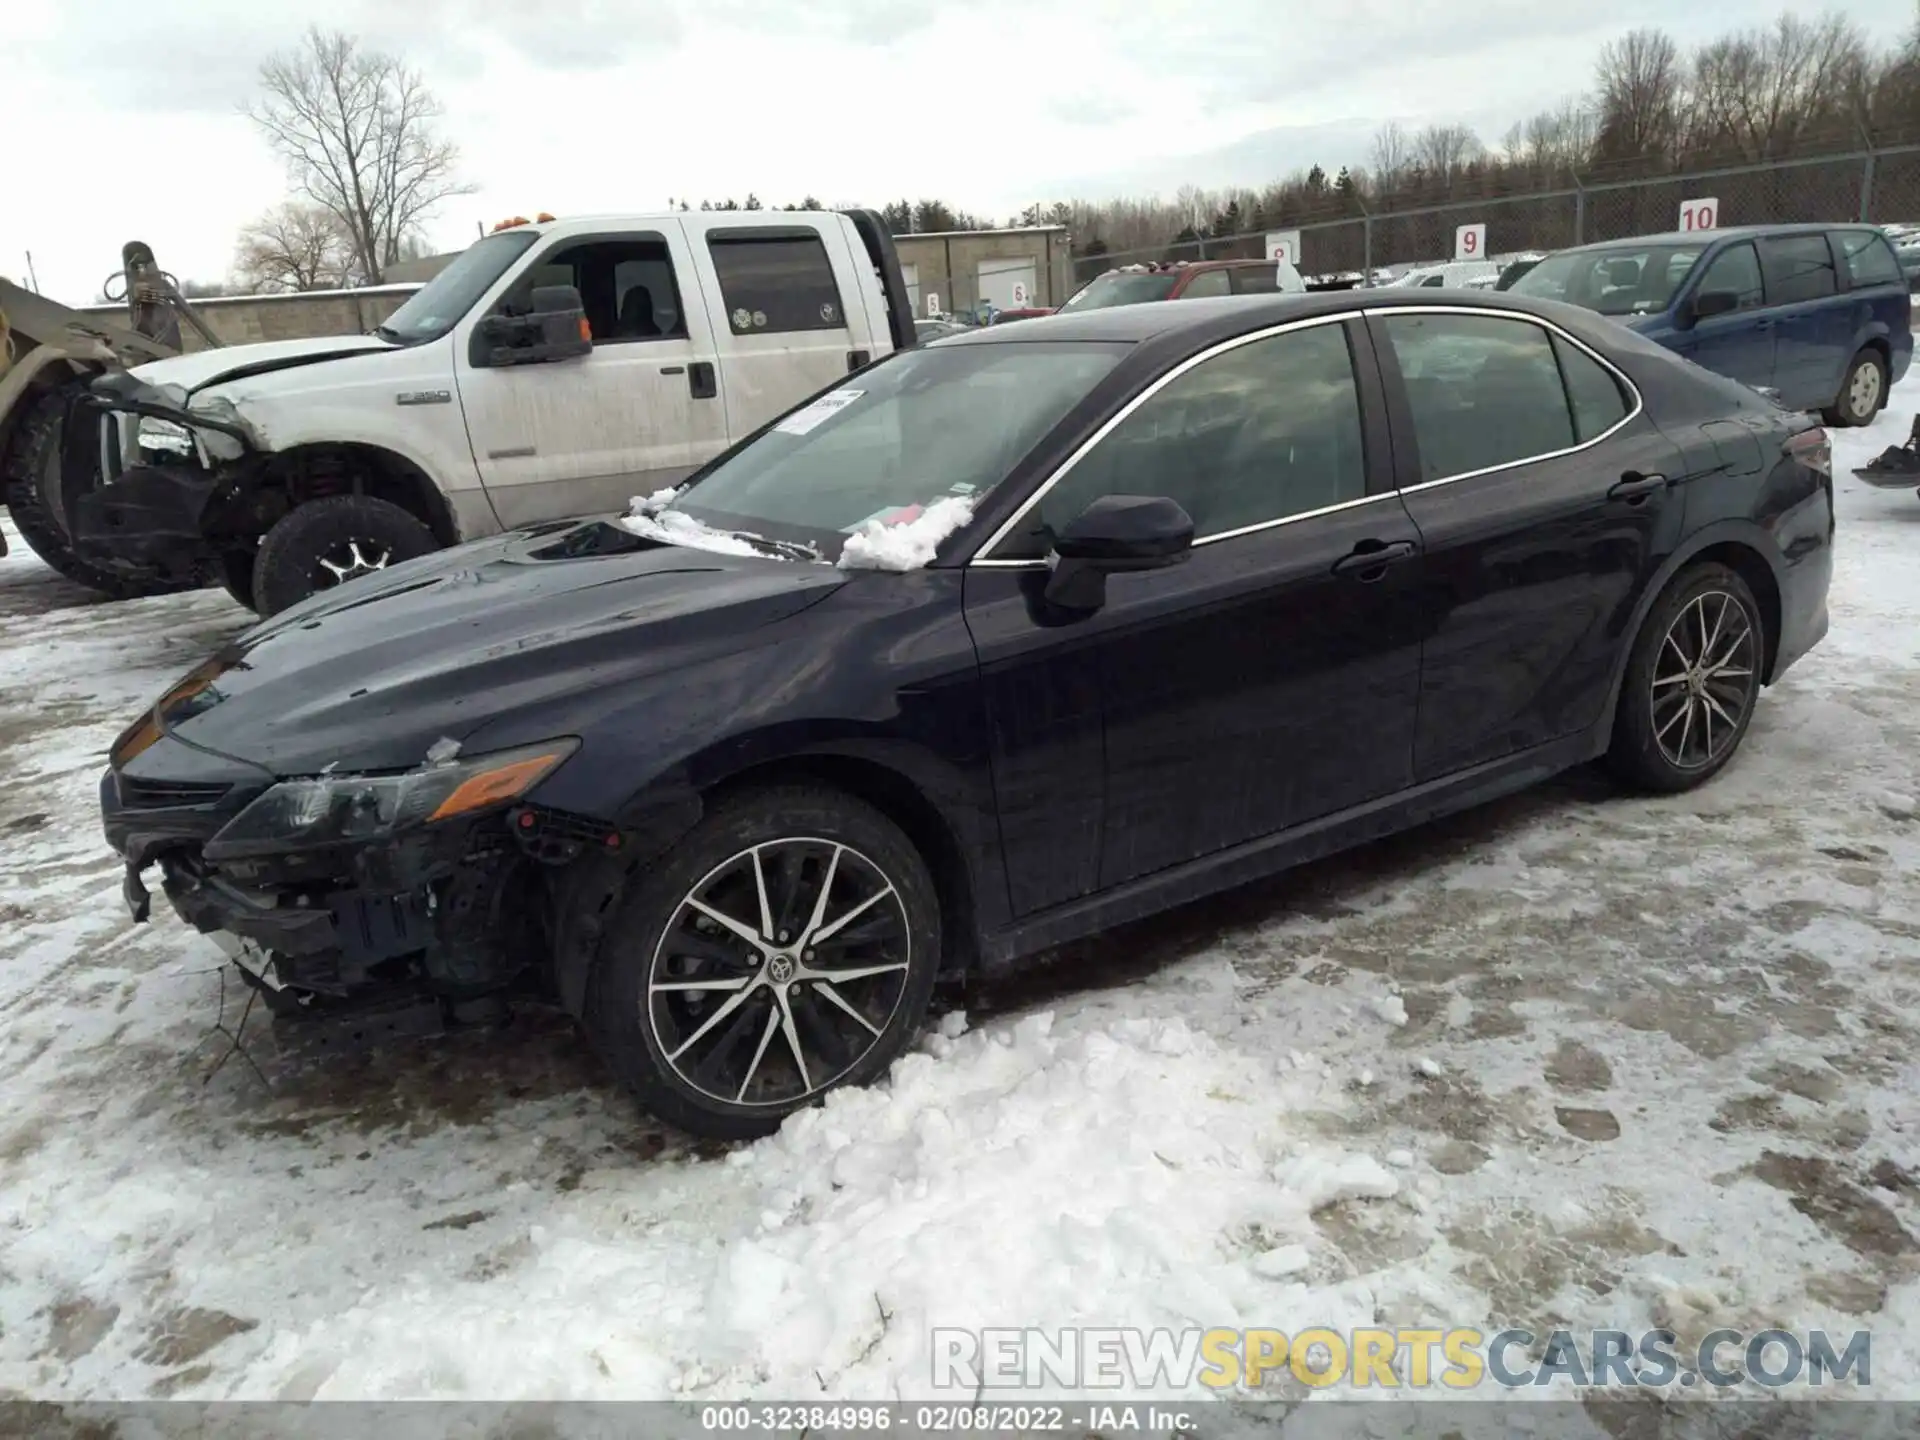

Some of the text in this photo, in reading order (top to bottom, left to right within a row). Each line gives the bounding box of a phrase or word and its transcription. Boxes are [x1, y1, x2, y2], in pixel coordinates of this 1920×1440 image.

[1682, 206, 1713, 231] 10
[1463, 231, 1477, 254] 9
[1015, 285, 1023, 302] 6
